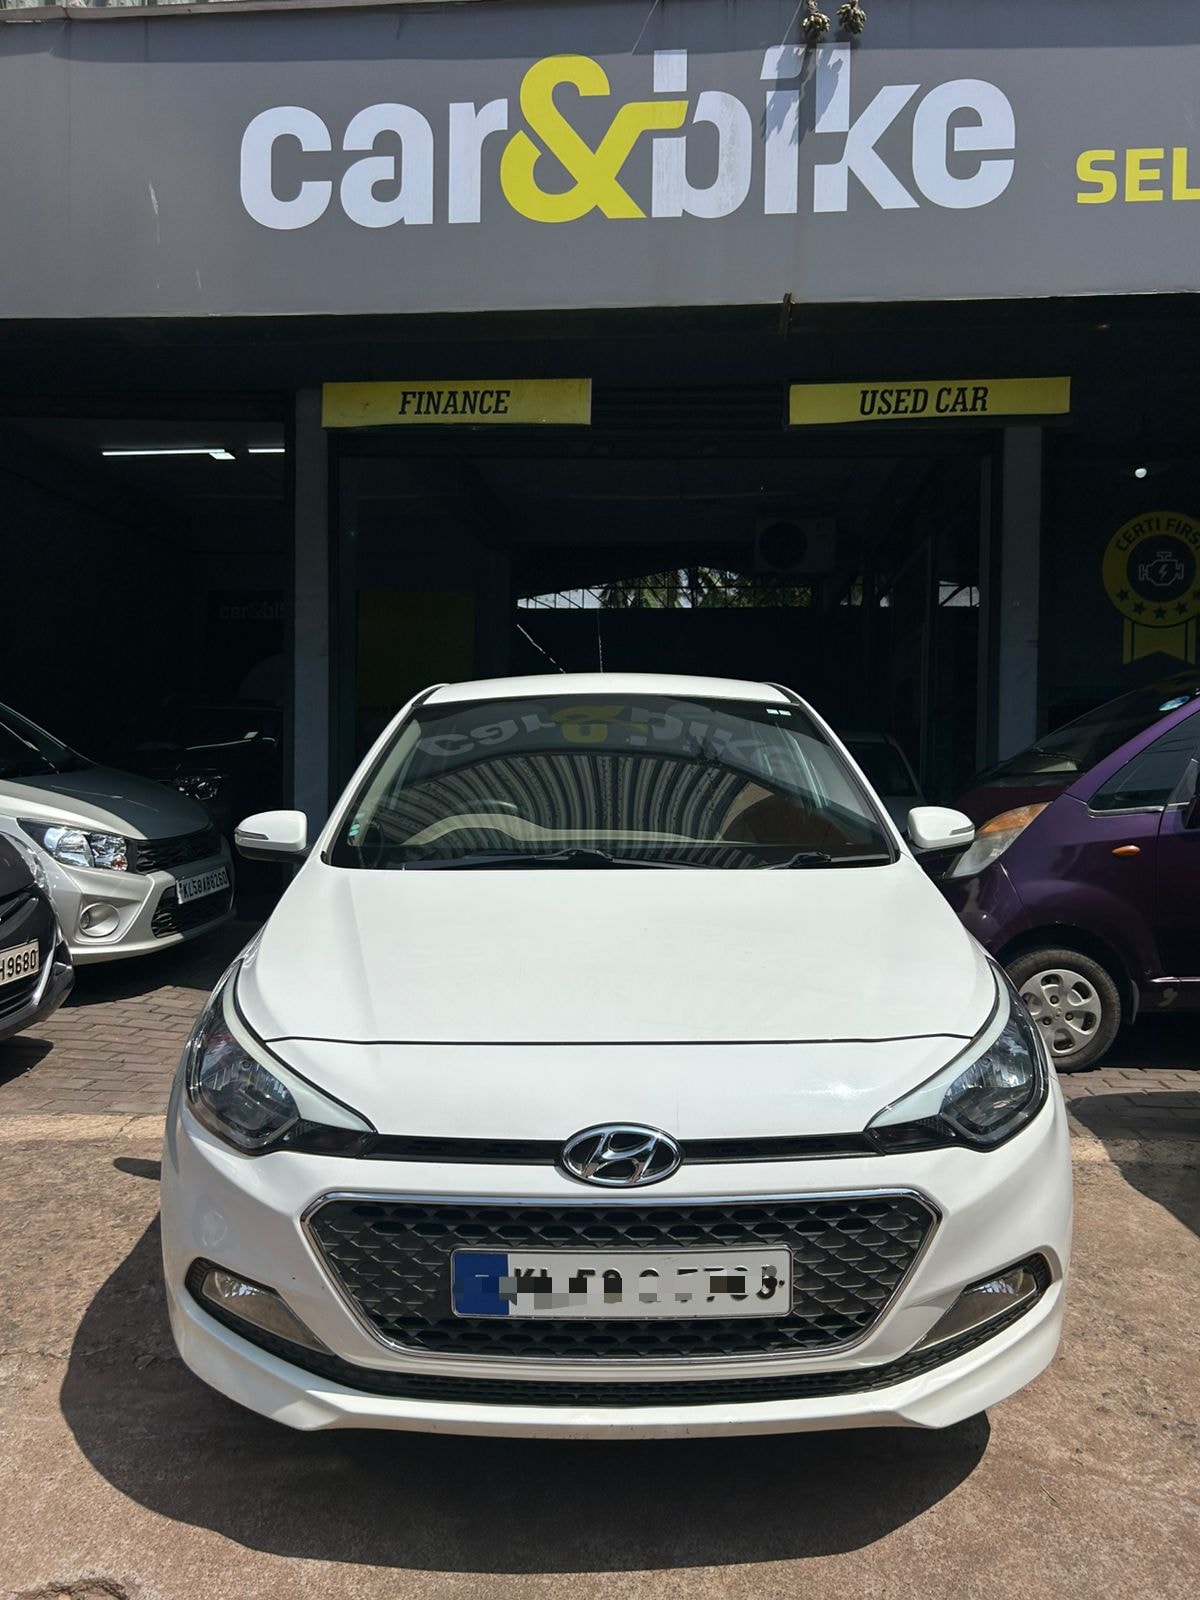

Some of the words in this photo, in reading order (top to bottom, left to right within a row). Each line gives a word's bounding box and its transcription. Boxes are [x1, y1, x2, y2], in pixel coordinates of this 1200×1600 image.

[240, 42, 1016, 230] car&bike
[1076, 147, 1200, 205] SEL
[398, 389, 510, 416] FINANCE
[859, 388, 928, 417] USED
[934, 386, 989, 414] CAR
[1116, 517, 1161, 552] CERTI
[1166, 518, 1200, 551] FIRS
